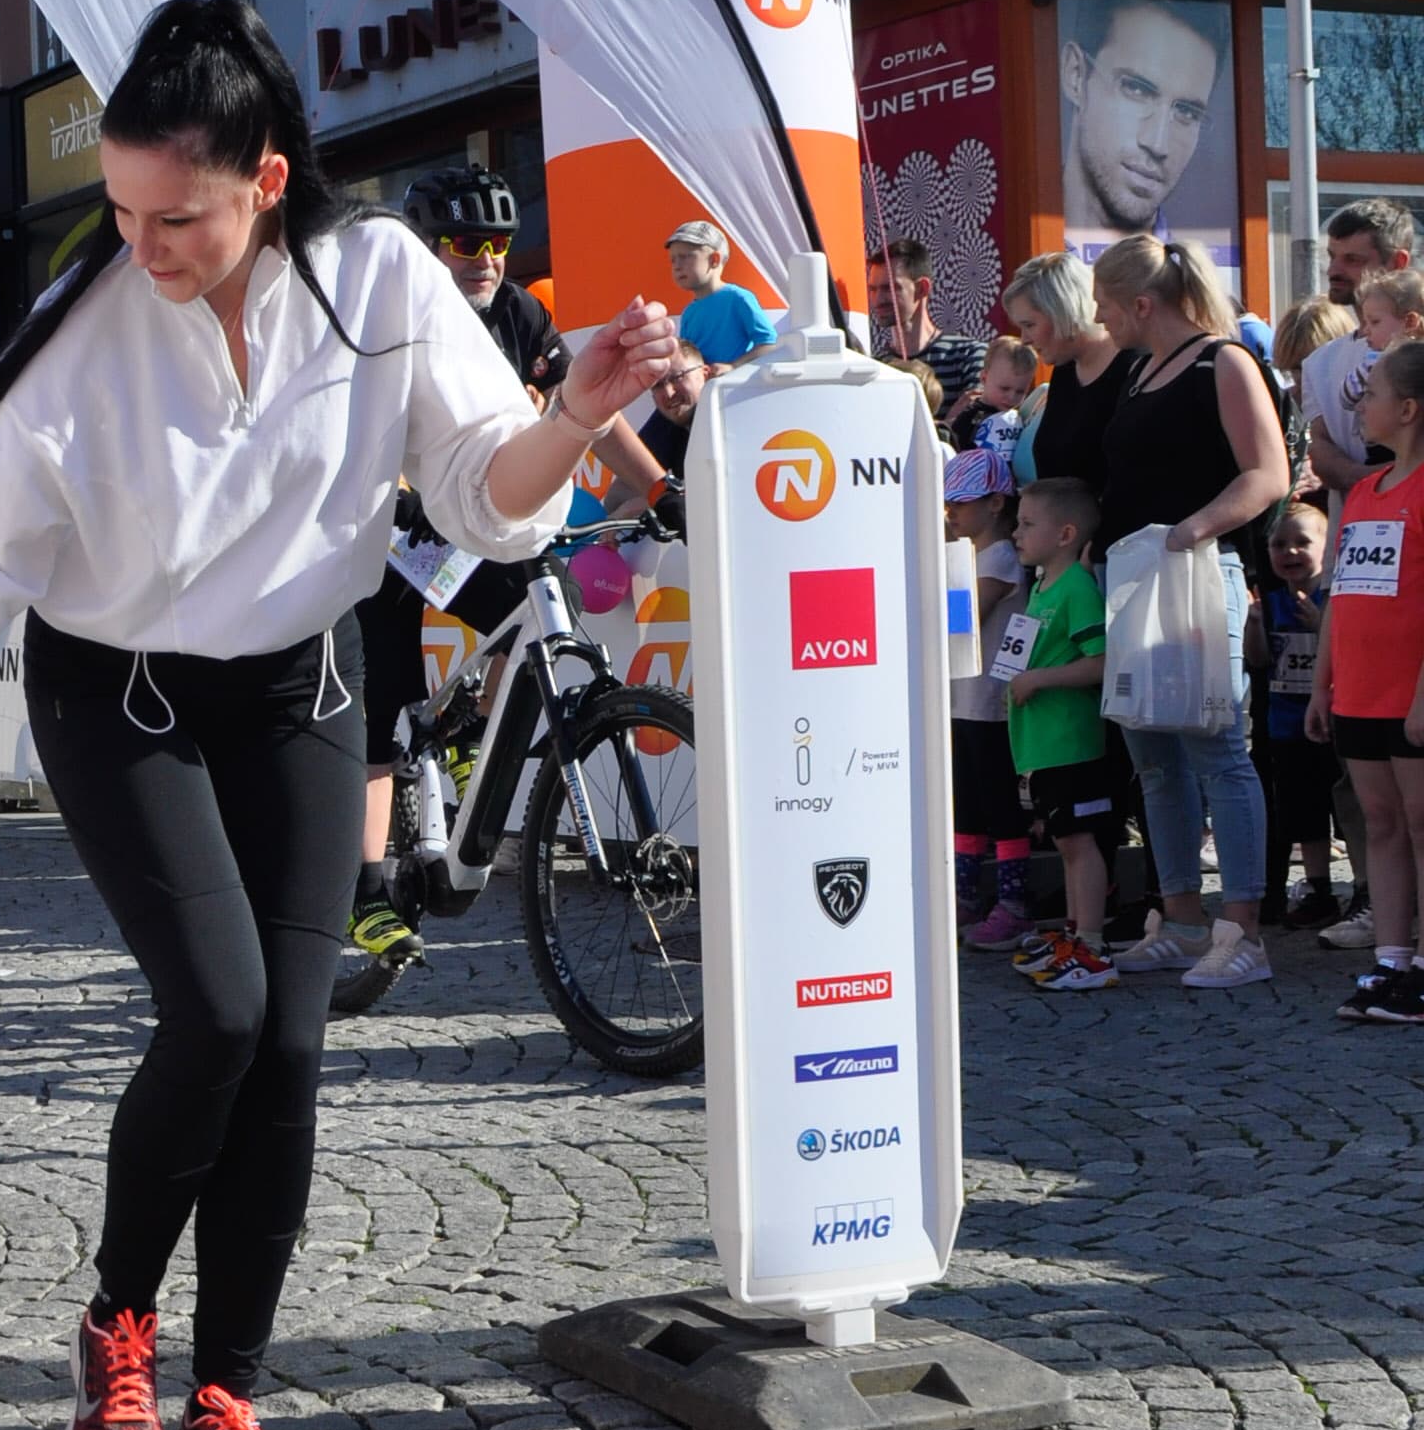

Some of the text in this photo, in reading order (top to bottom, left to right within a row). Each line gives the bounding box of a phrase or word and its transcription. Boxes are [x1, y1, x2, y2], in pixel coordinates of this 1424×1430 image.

[880, 42, 948, 71] OPTIKA
[859, 65, 996, 122] UNETTES
[852, 457, 901, 486] NN
[1345, 546, 1396, 566] 3042
[800, 638, 868, 662] AVON
[862, 749, 900, 761] Powered
[862, 759, 900, 773] by MVM
[775, 794, 832, 815] innogy
[801, 977, 889, 1000] NUTREND
[830, 1126, 901, 1154] ŠKODA
[812, 1214, 892, 1246] KPMG
